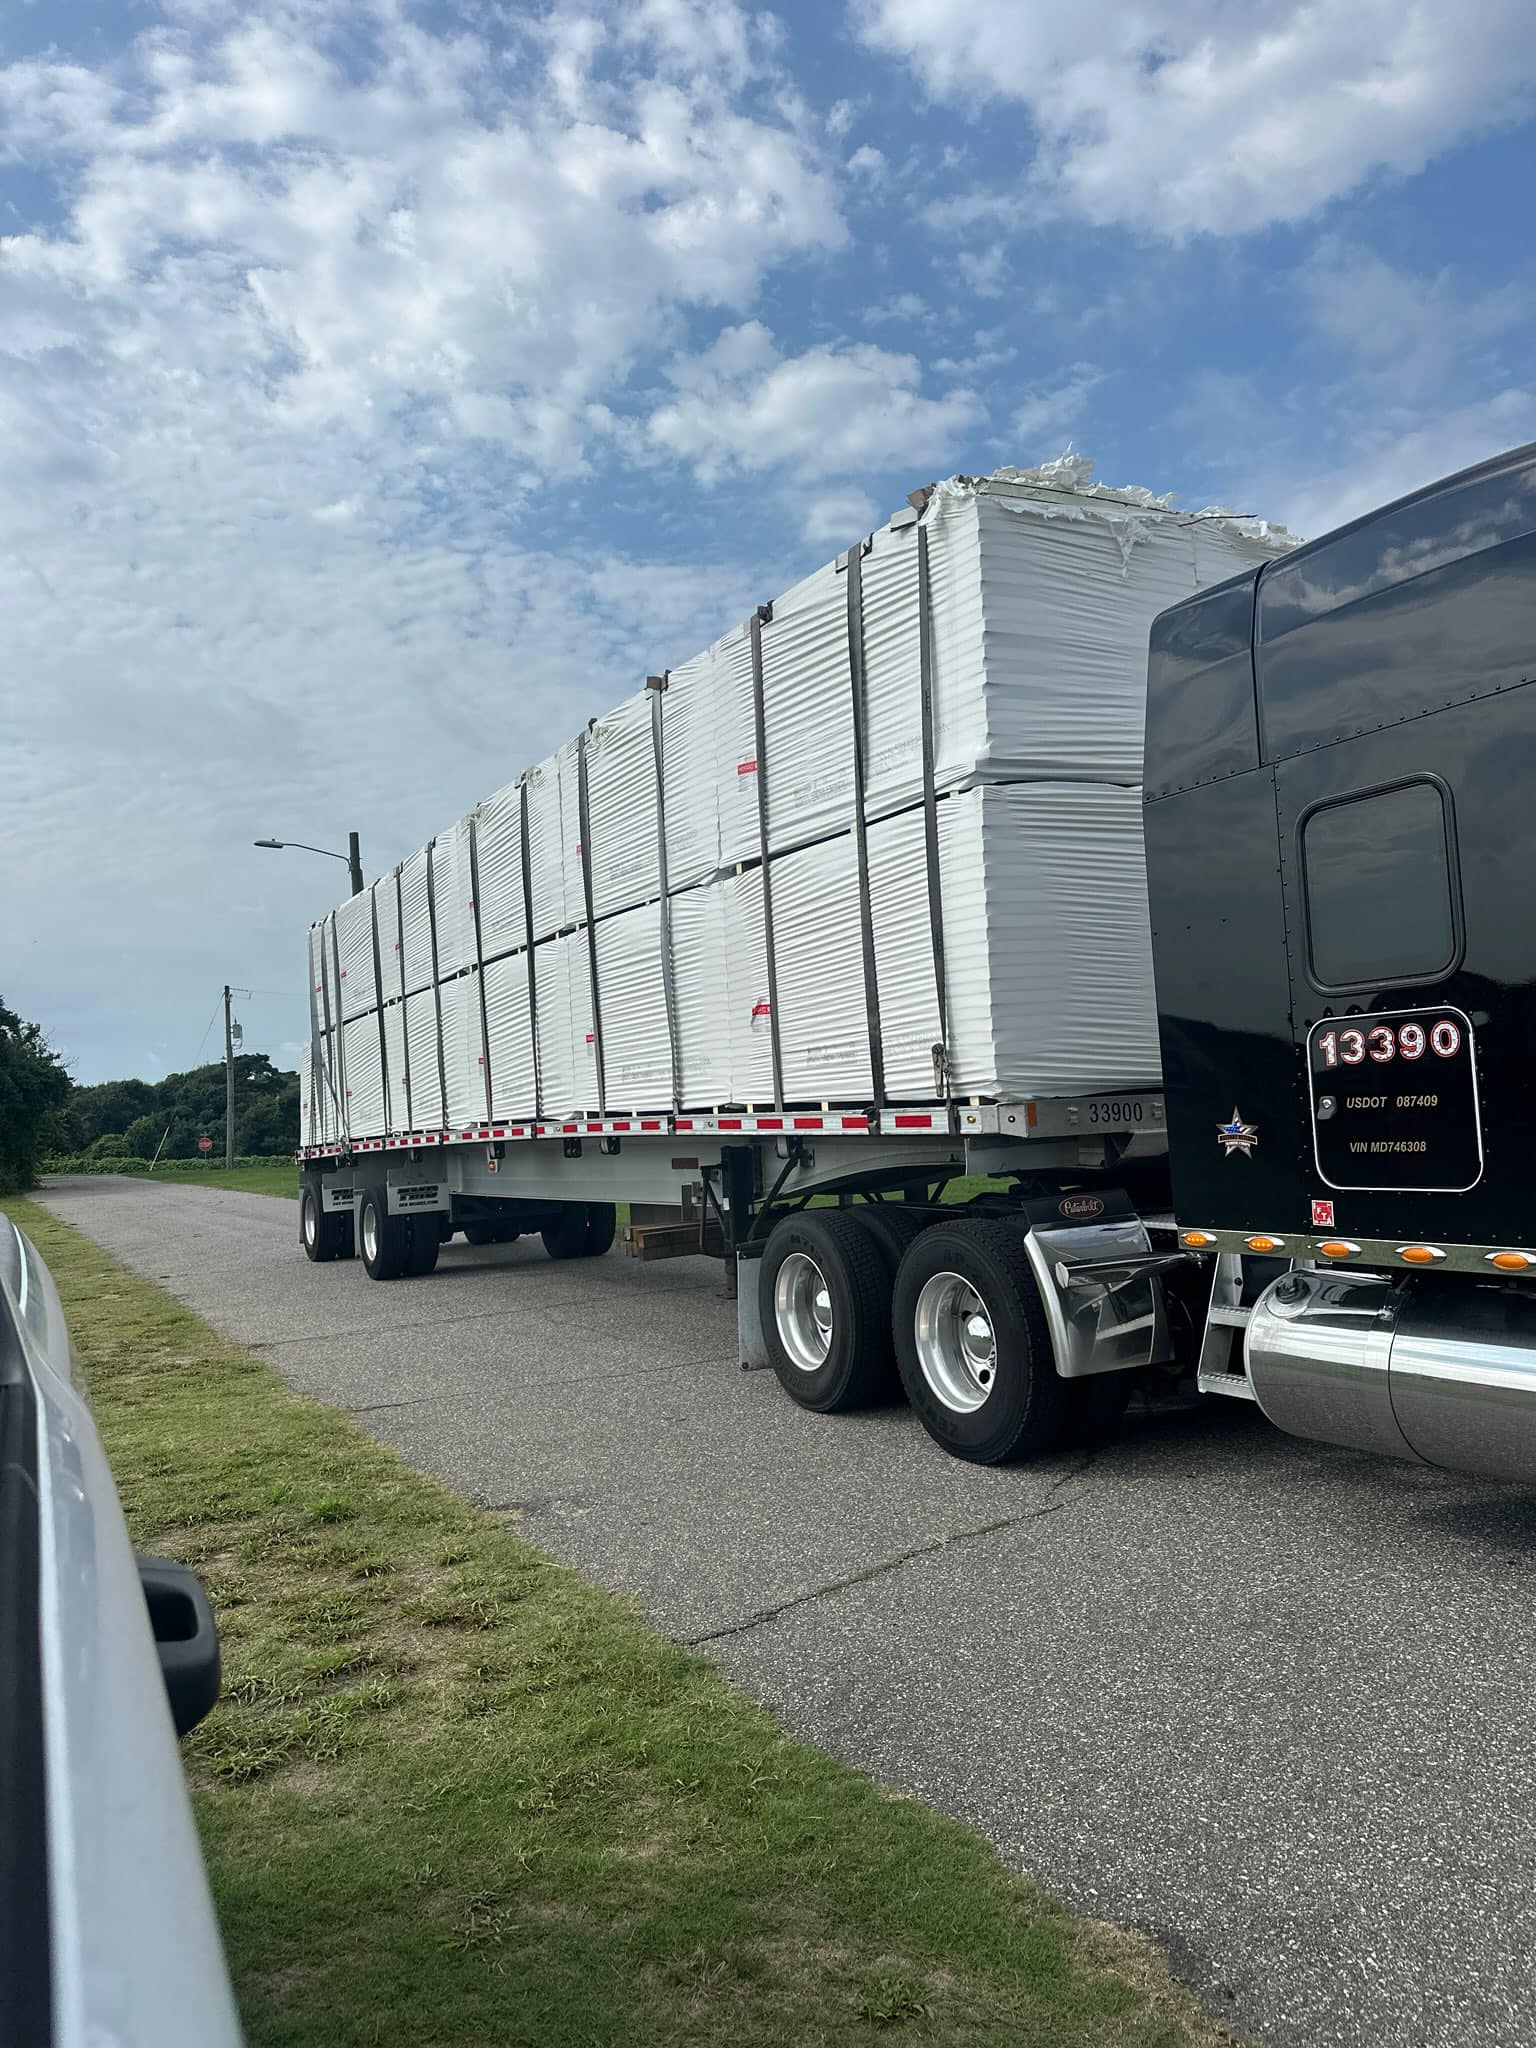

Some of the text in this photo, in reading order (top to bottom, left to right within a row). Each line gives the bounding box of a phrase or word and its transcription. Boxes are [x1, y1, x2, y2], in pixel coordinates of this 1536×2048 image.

[1319, 1020, 1460, 1066] 13390
[1346, 1095, 1438, 1108] USDOT 087409
[1088, 1103, 1143, 1123] 33900
[1349, 1141, 1427, 1153] VIN MD746308
[1064, 1200, 1099, 1215] Peterbilt
